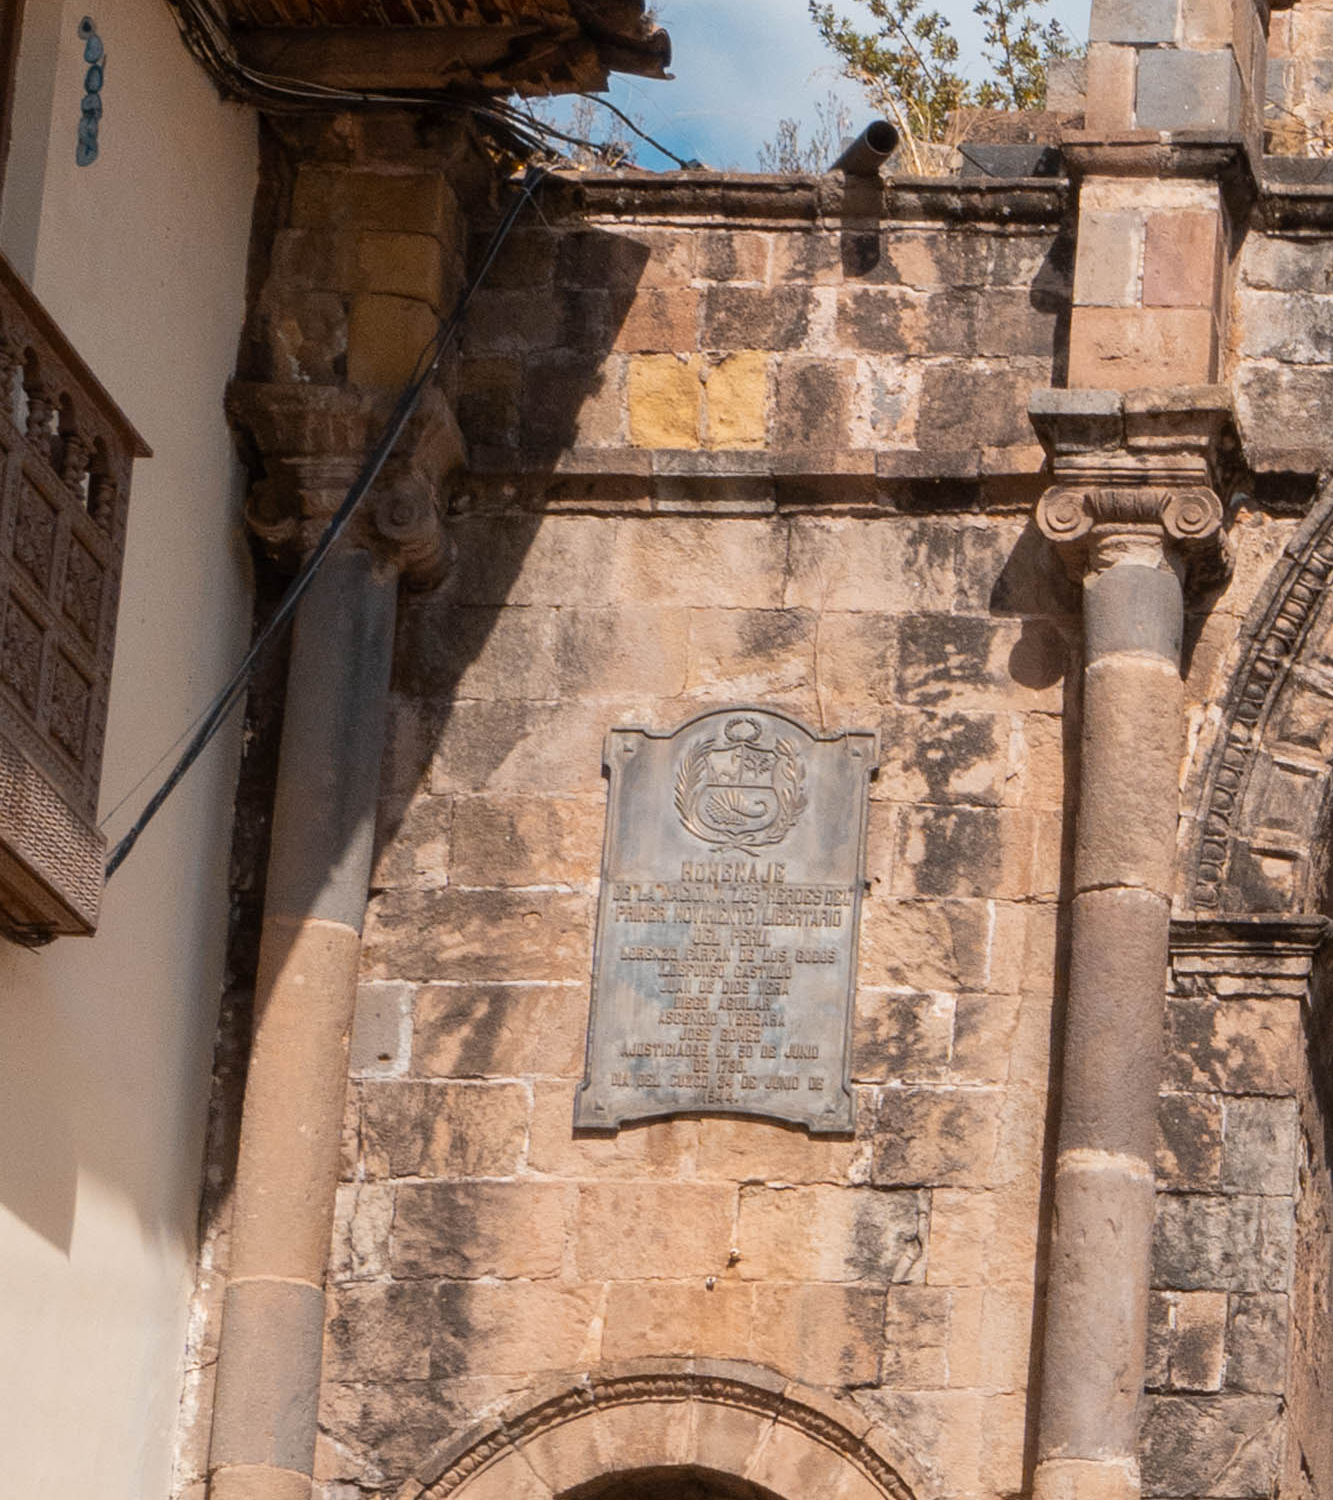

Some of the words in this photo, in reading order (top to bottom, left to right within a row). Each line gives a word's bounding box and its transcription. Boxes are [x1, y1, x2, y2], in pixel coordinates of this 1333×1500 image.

[680, 861, 786, 884] HOMENAJE
[738, 949, 756, 963] DE
[762, 949, 789, 963] LOS
[698, 981, 715, 995] DE
[721, 981, 750, 996] DIOS
[760, 1045, 777, 1060] DE
[784, 1045, 820, 1060] JUNIO
[692, 1059, 710, 1074] DE
[740, 1076, 758, 1090] DE
[807, 1077, 825, 1092] DE
